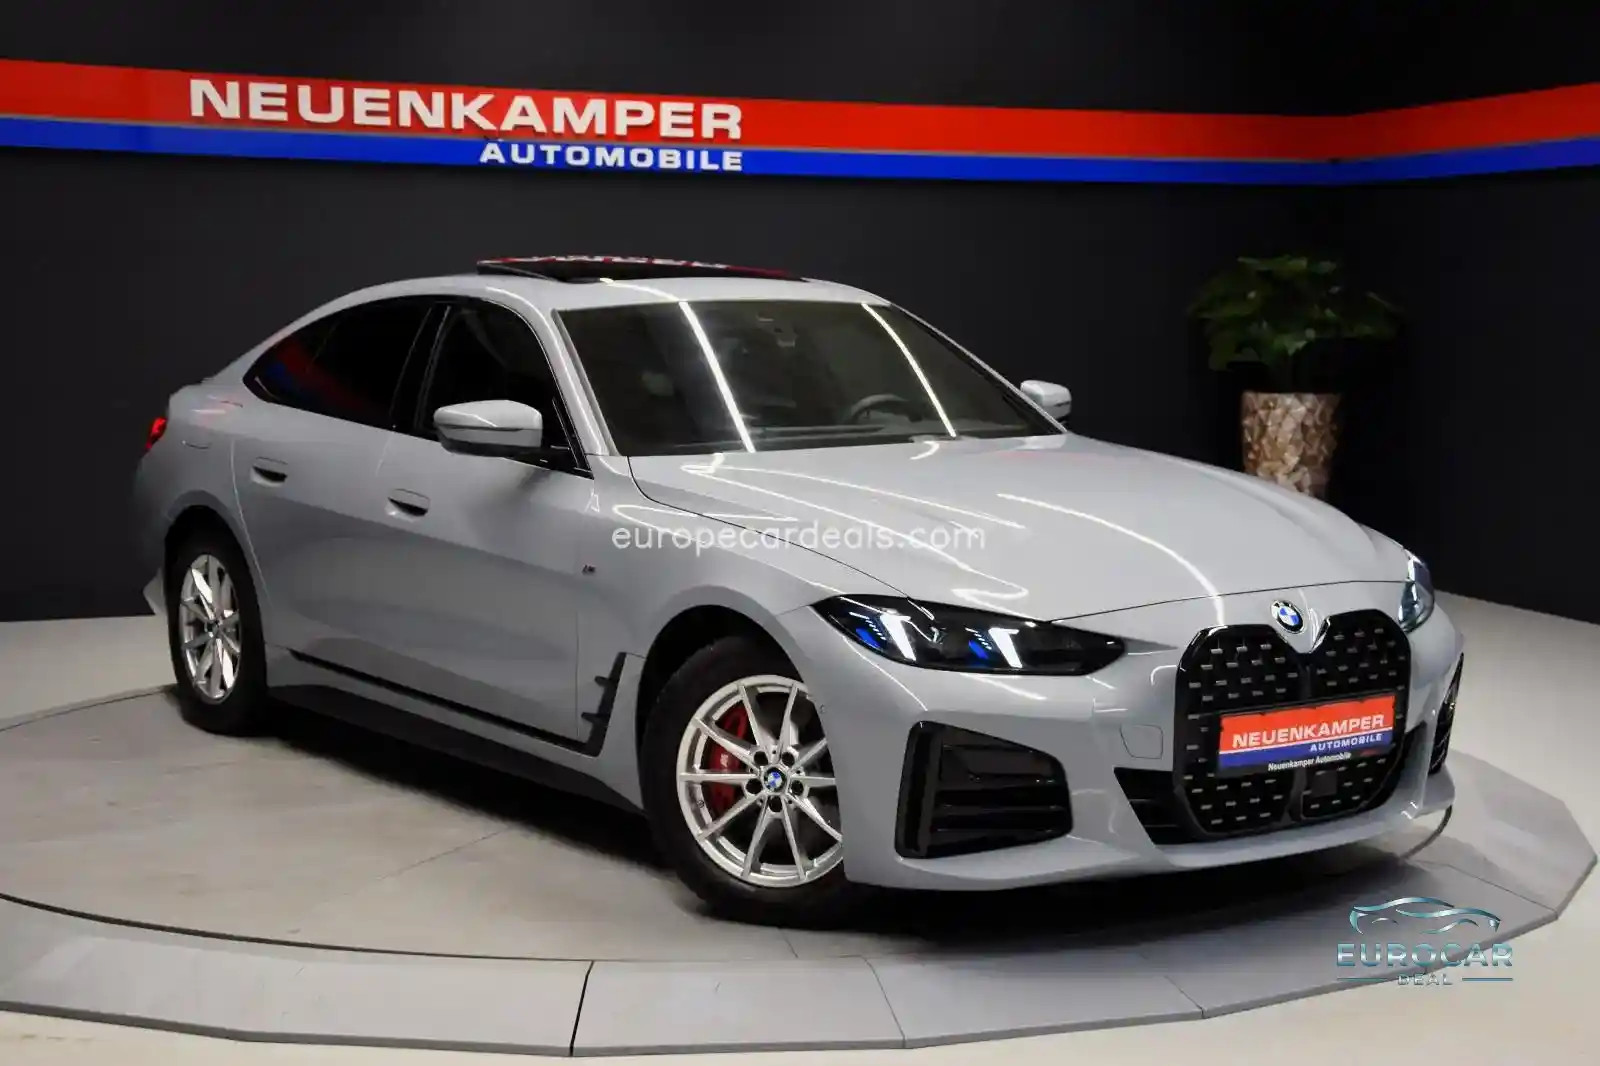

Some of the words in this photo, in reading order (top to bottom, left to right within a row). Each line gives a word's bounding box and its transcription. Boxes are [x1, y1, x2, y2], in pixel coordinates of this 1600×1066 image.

[189, 78, 742, 140] NEUENKAMPER
[479, 142, 743, 171] AUTOMOBILE
[1232, 714, 1385, 748] NEUENKAMPER
[1309, 733, 1382, 753] AUTOMOBILE
[1267, 758, 1315, 771] Neuenkamper
[1315, 752, 1352, 764] Automobile
